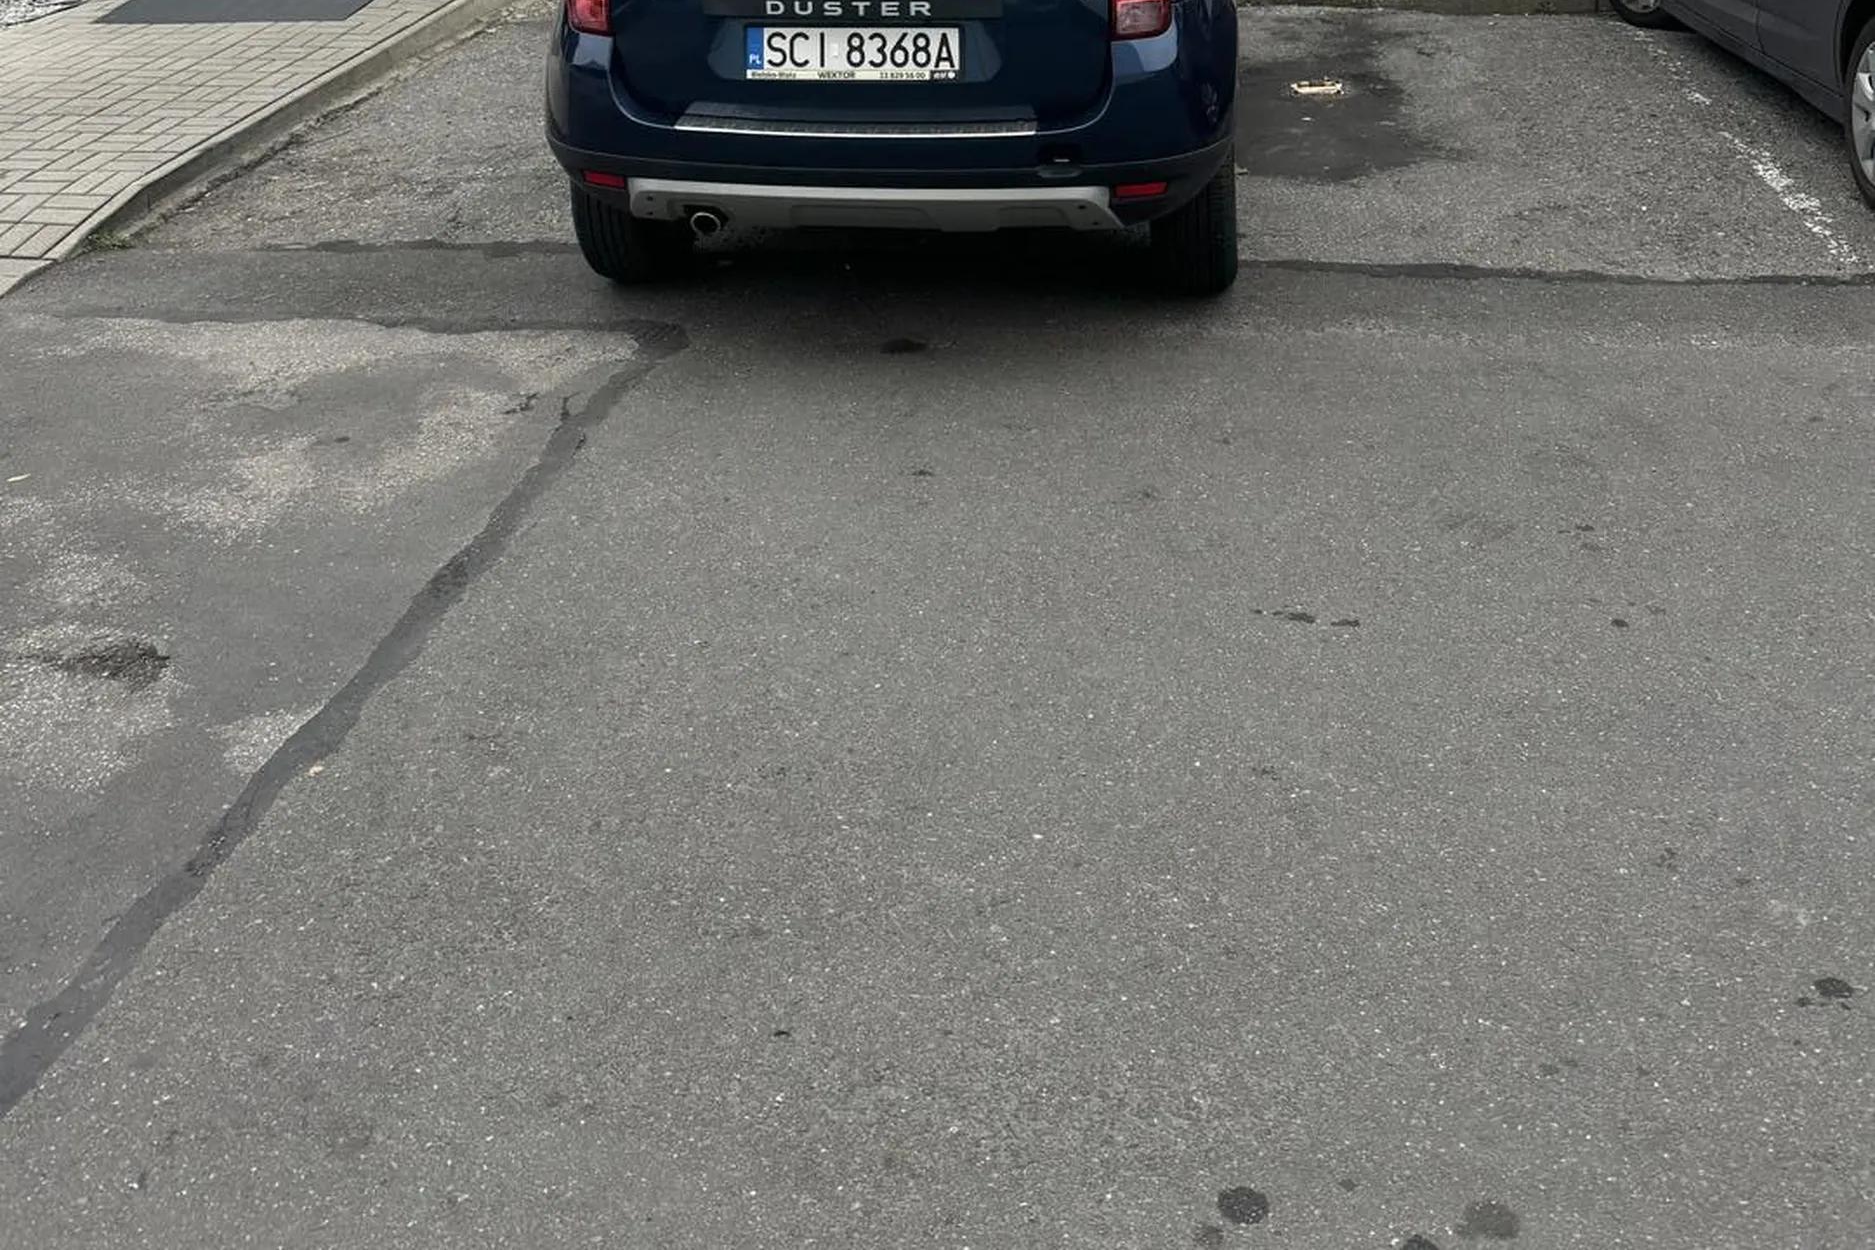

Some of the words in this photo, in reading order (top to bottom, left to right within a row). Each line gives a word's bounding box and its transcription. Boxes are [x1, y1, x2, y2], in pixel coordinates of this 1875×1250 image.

[765, 0, 932, 16] DUSTER
[766, 32, 825, 68] SCI
[846, 32, 956, 68] 8368A
[749, 53, 762, 65] PL
